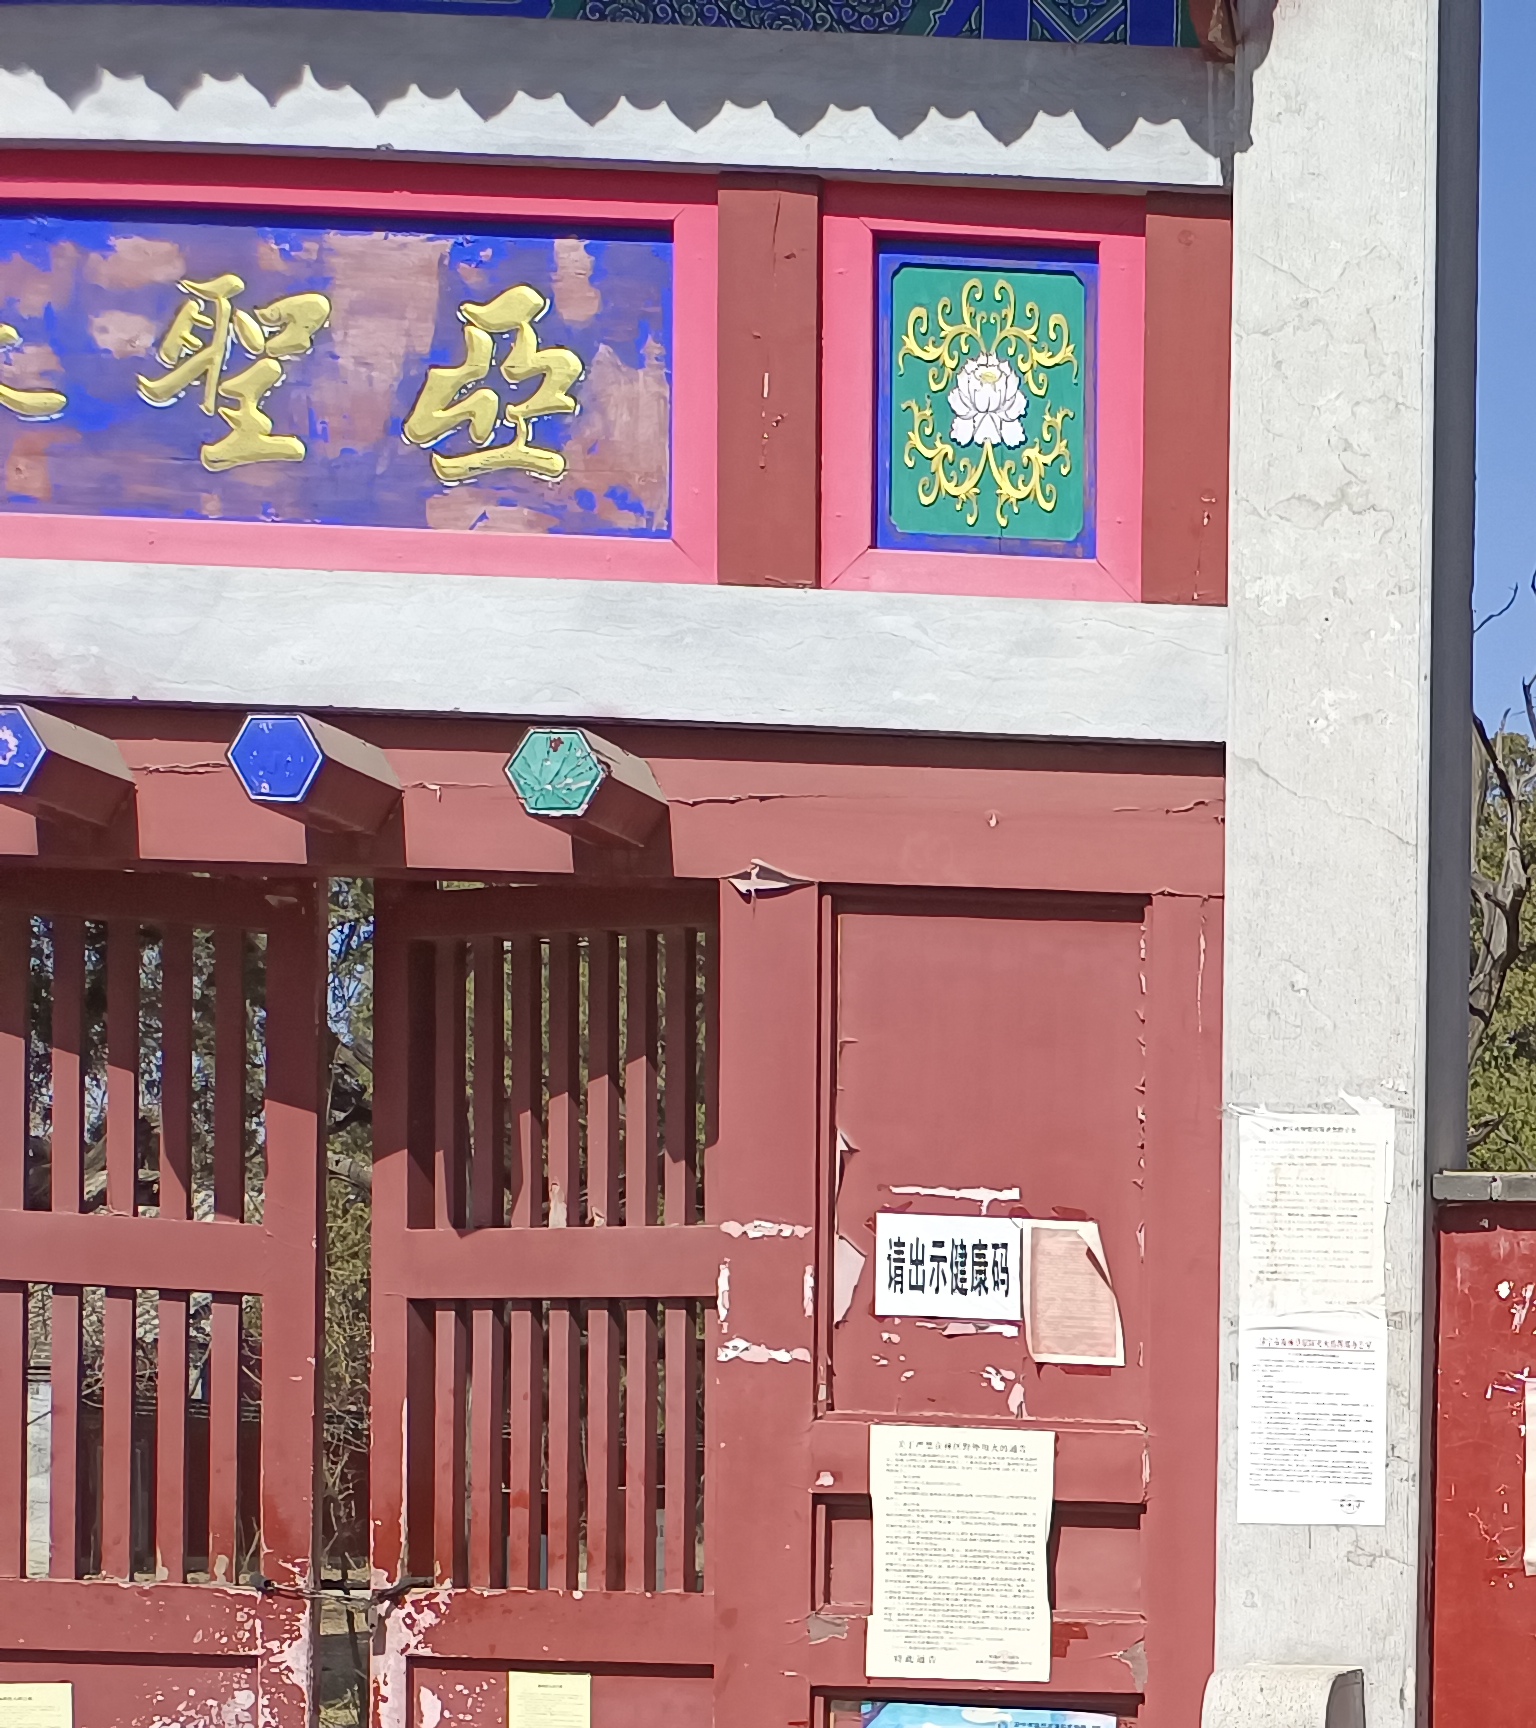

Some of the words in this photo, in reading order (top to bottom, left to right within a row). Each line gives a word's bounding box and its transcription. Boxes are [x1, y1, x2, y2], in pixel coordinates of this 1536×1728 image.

[886, 1236, 1010, 1298] 请出示健康码
